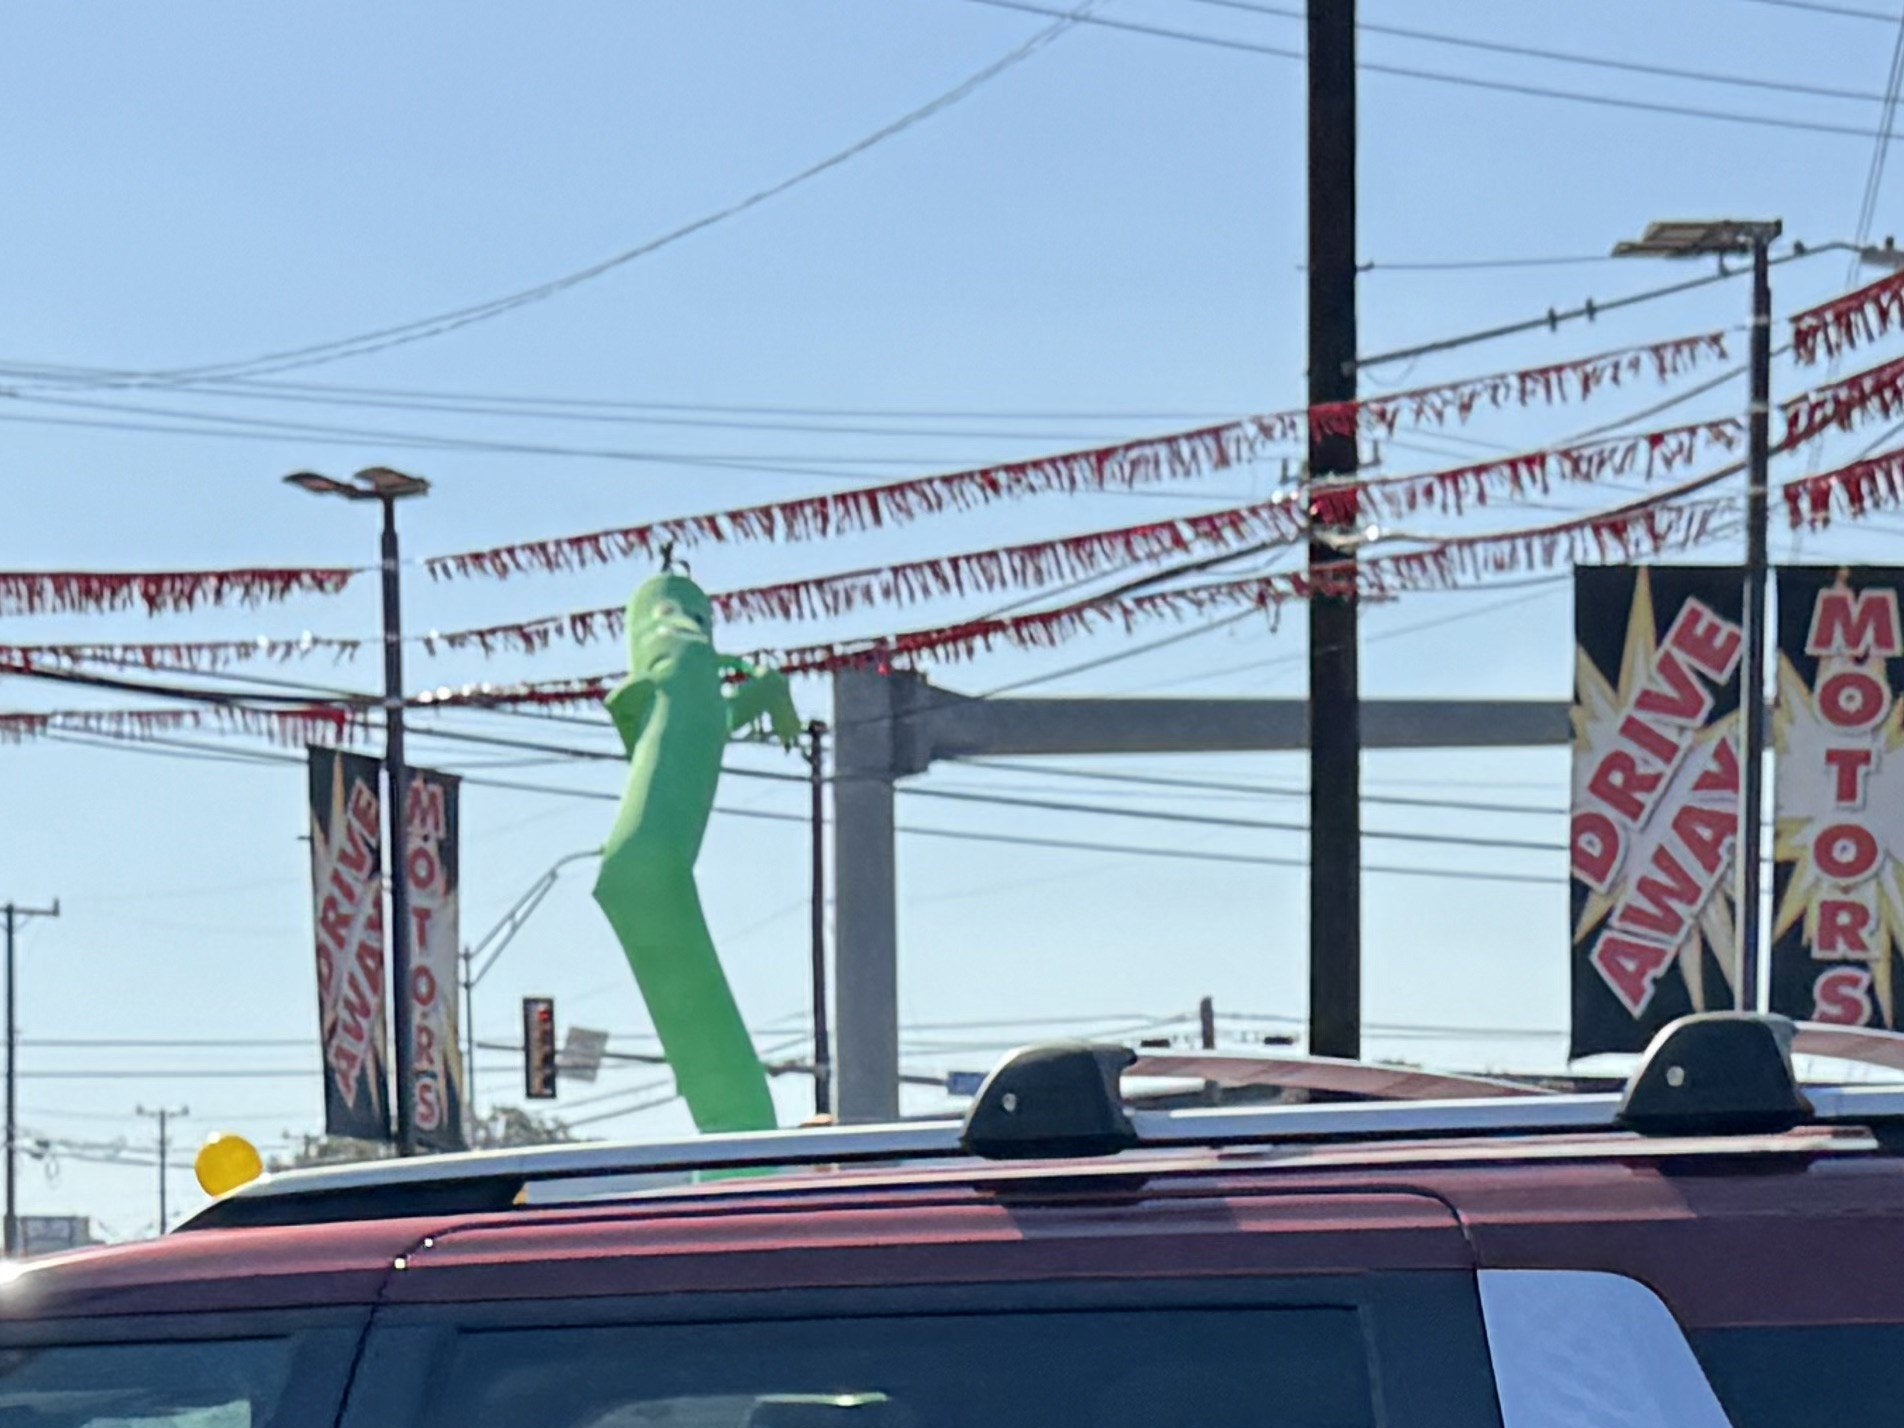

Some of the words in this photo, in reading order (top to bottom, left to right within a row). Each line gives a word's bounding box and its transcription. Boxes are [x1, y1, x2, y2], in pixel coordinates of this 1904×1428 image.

[1571, 597, 1742, 886] DRIVE
[1594, 738, 1739, 1012] AWAY
[1810, 592, 1900, 1025] MOTORS
[317, 780, 380, 996] DRIVE
[406, 784, 442, 1124] MOTORS
